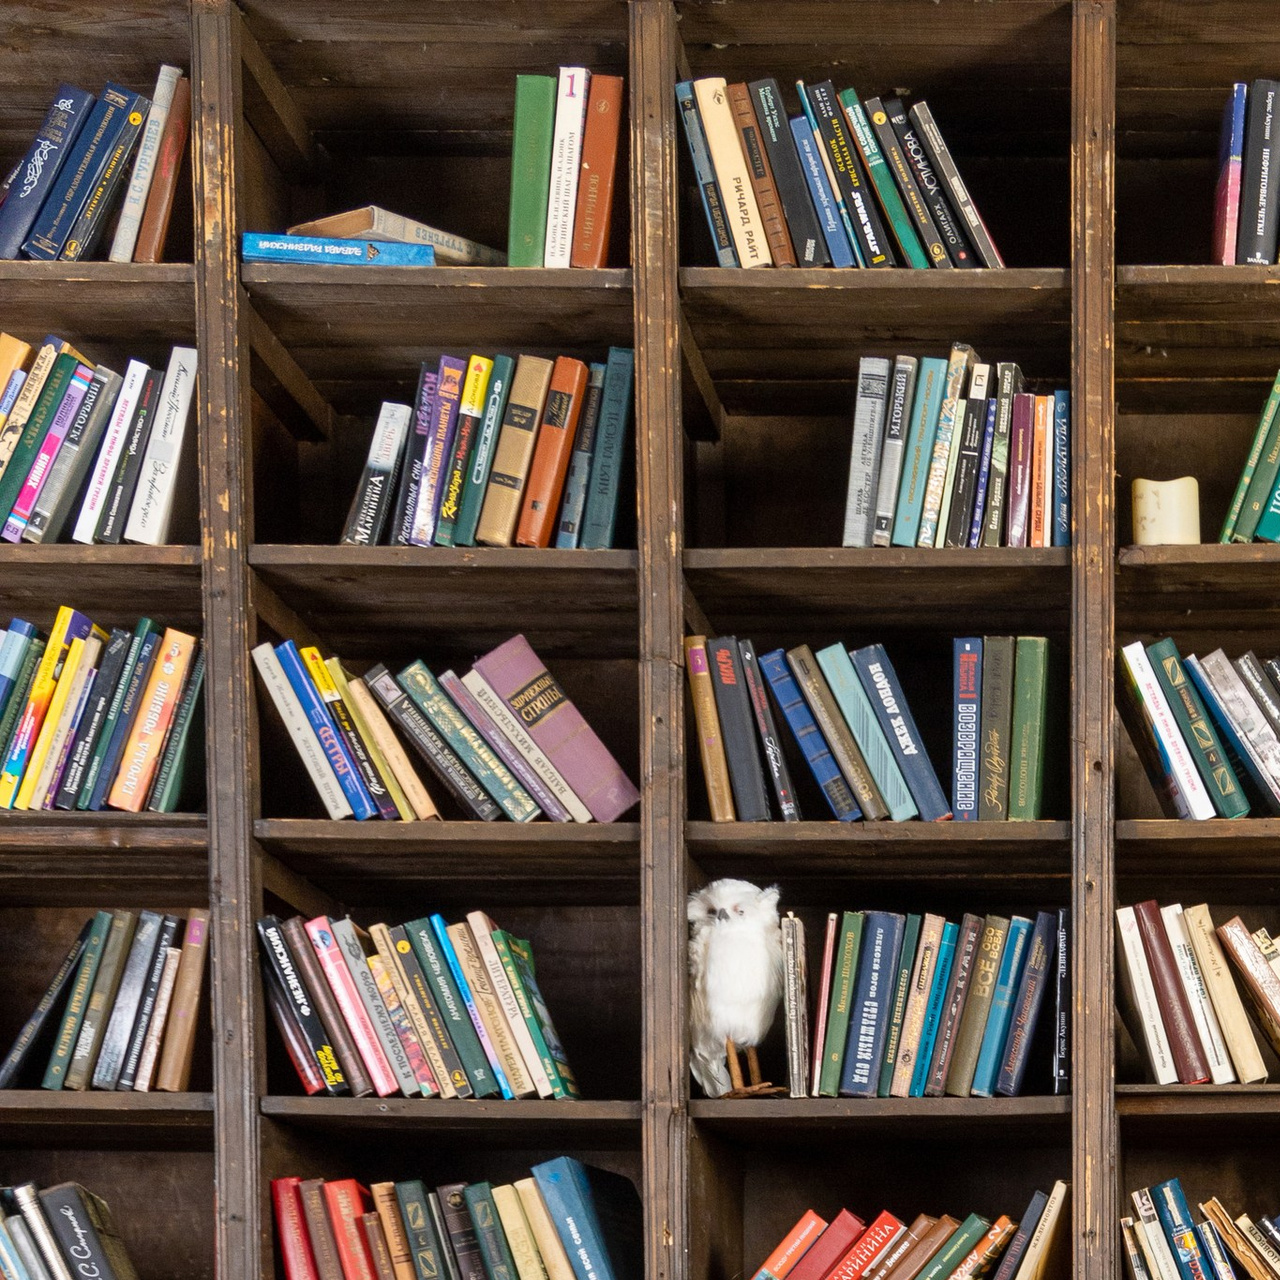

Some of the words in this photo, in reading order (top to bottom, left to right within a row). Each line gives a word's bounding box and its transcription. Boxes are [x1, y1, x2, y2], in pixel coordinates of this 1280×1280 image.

[566, 74, 577, 98] 1
[1265, 91, 1275, 113] Борис
[758, 88, 770, 115] Машина
[765, 115, 777, 142] времени
[1262, 114, 1273, 139] Акунин
[134, 118, 161, 182] ТУРГЕНЕВ
[903, 129, 939, 195] УСТИНОВА
[1258, 149, 1270, 206] НЕФРИТОВЫЕ
[732, 177, 751, 226] РИЧАРД
[743, 229, 758, 261] РАЙТ
[933, 203, 956, 244] ОЛИГАРХ
[1256, 207, 1266, 235] ЧЕТКИ
[259, 239, 323, 253] РАДЗИНСКИЙ
[324, 244, 361, 256] ЭДВАРД
[69, 380, 100, 440] М.ГОРЬКИЙ
[889, 372, 907, 435] М.ГОРЬКИЙ
[426, 441, 444, 485] ЖЕНЩИНЫ
[436, 401, 453, 439] ПЛАНЕТЫ
[1056, 417, 1068, 496] АХМАТОВА
[27, 452, 50, 489] ХИМИЯ
[354, 472, 387, 543] МАРИНИНА
[358, 483, 373, 525] АЛЕКСАНДРА
[398, 482, 418, 544] Расколотые
[410, 459, 423, 479] сны
[1056, 503, 1067, 531] Анна
[867, 660, 900, 716] ЛОНДОН
[120, 740, 150, 796] ГАРОЛЬД
[141, 680, 171, 736] РОББИНС
[401, 698, 444, 749] МАРИНИНА
[476, 686, 534, 753] МИХАЛЬСКИЙ
[890, 714, 917, 757] ДЖЕК
[318, 725, 348, 776] СЕСТРЫ
[440, 747, 487, 802] АЛЕКСАНДРА
[532, 755, 567, 794] ВАЦЛАВ
[417, 928, 443, 976] ЧЕЛОВЕКА
[841, 931, 854, 978] ШОЛОХОВ
[871, 928, 884, 970] АЛЕКСЕЙ
[981, 926, 995, 950] ОБО
[990, 928, 1005, 958] ВСЕМ
[265, 925, 312, 1018] Ф.НЕЗНАНСКИЙ
[487, 957, 518, 1019] ЛИТЕРАТУРА
[868, 972, 878, 998] ЮГОВ
[975, 959, 996, 997] ВСЕ
[435, 974, 461, 1022] АНАТОМИЯ
[837, 979, 849, 1013] Михаил
[408, 1002, 428, 1037] МАРИЯ
[856, 1001, 880, 1059] СТРАШНЫЙ
[1005, 1026, 1026, 1074] Александр
[1017, 978, 1037, 1026] Чаковский
[1059, 1011, 1067, 1037] Акунин
[885, 1025, 899, 1063] ДЕТЕКТИВ
[1058, 1038, 1066, 1058] Борис
[502, 1051, 527, 1091] АНДРЕЙ
[852, 1061, 870, 1084] СУД
[564, 1215, 583, 1245] семьи
[576, 1246, 593, 1271] всей
